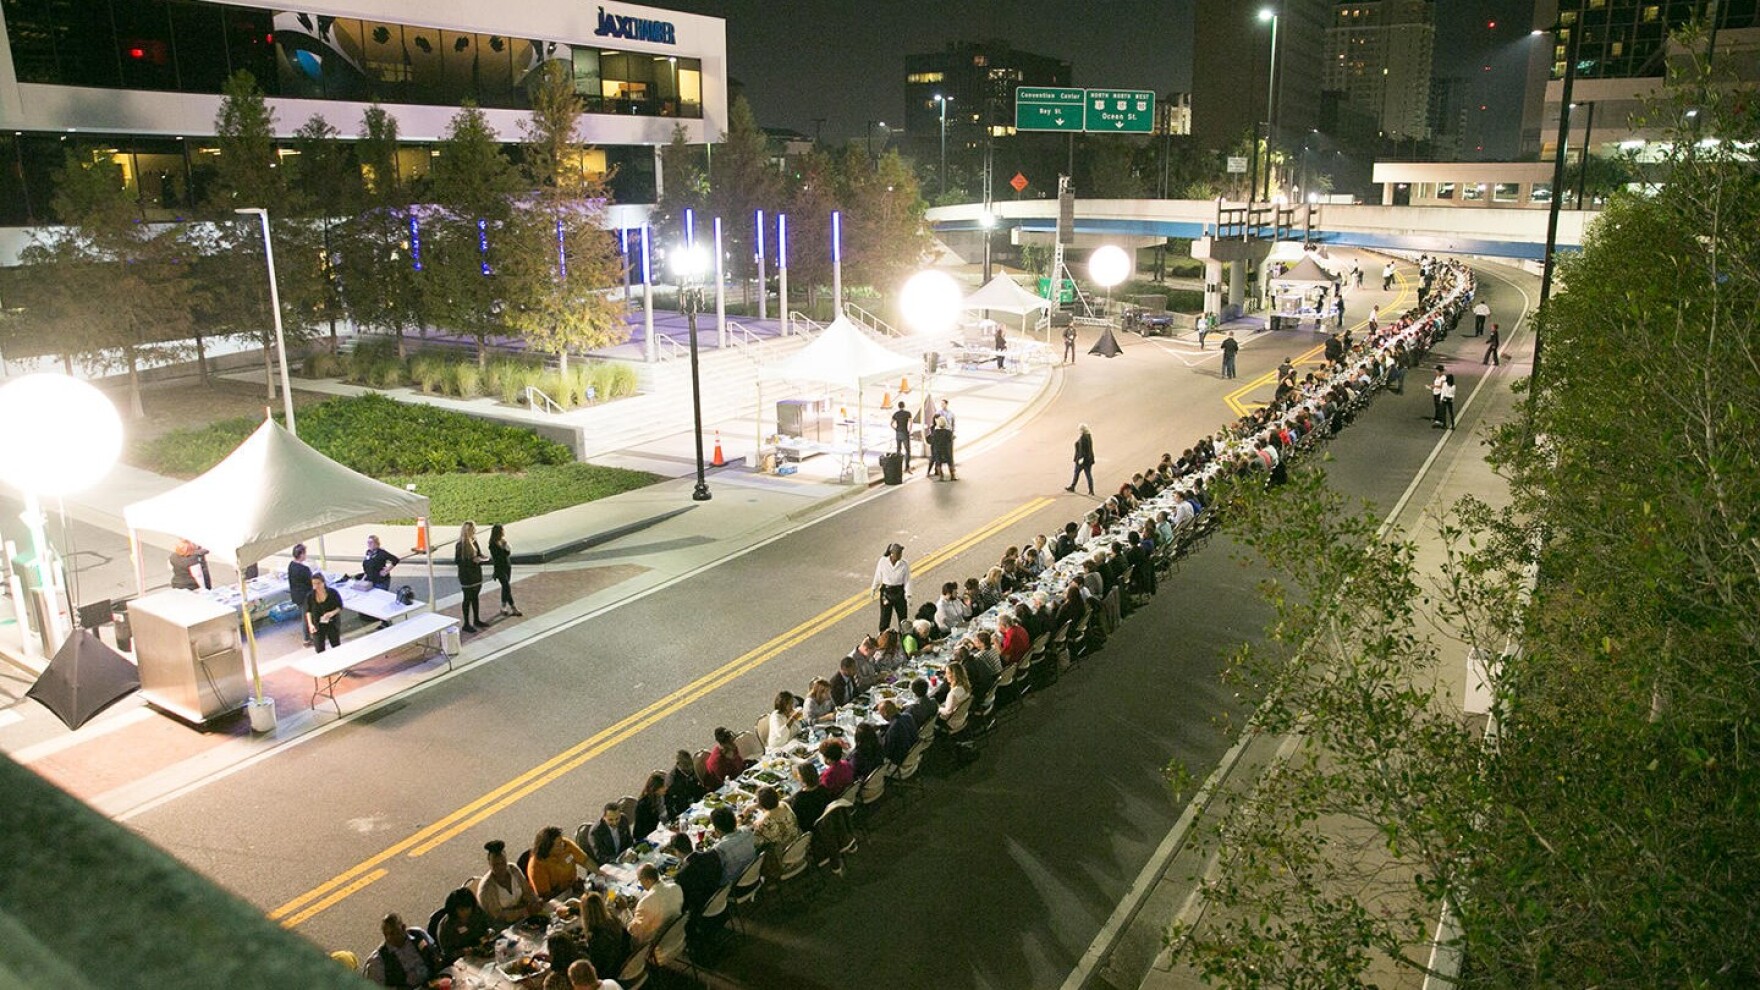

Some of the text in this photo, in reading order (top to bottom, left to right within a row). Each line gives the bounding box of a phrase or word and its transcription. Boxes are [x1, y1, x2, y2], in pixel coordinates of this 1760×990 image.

[1039, 107, 1051, 116] Bay
[1101, 112, 1137, 121] Ocean St.
